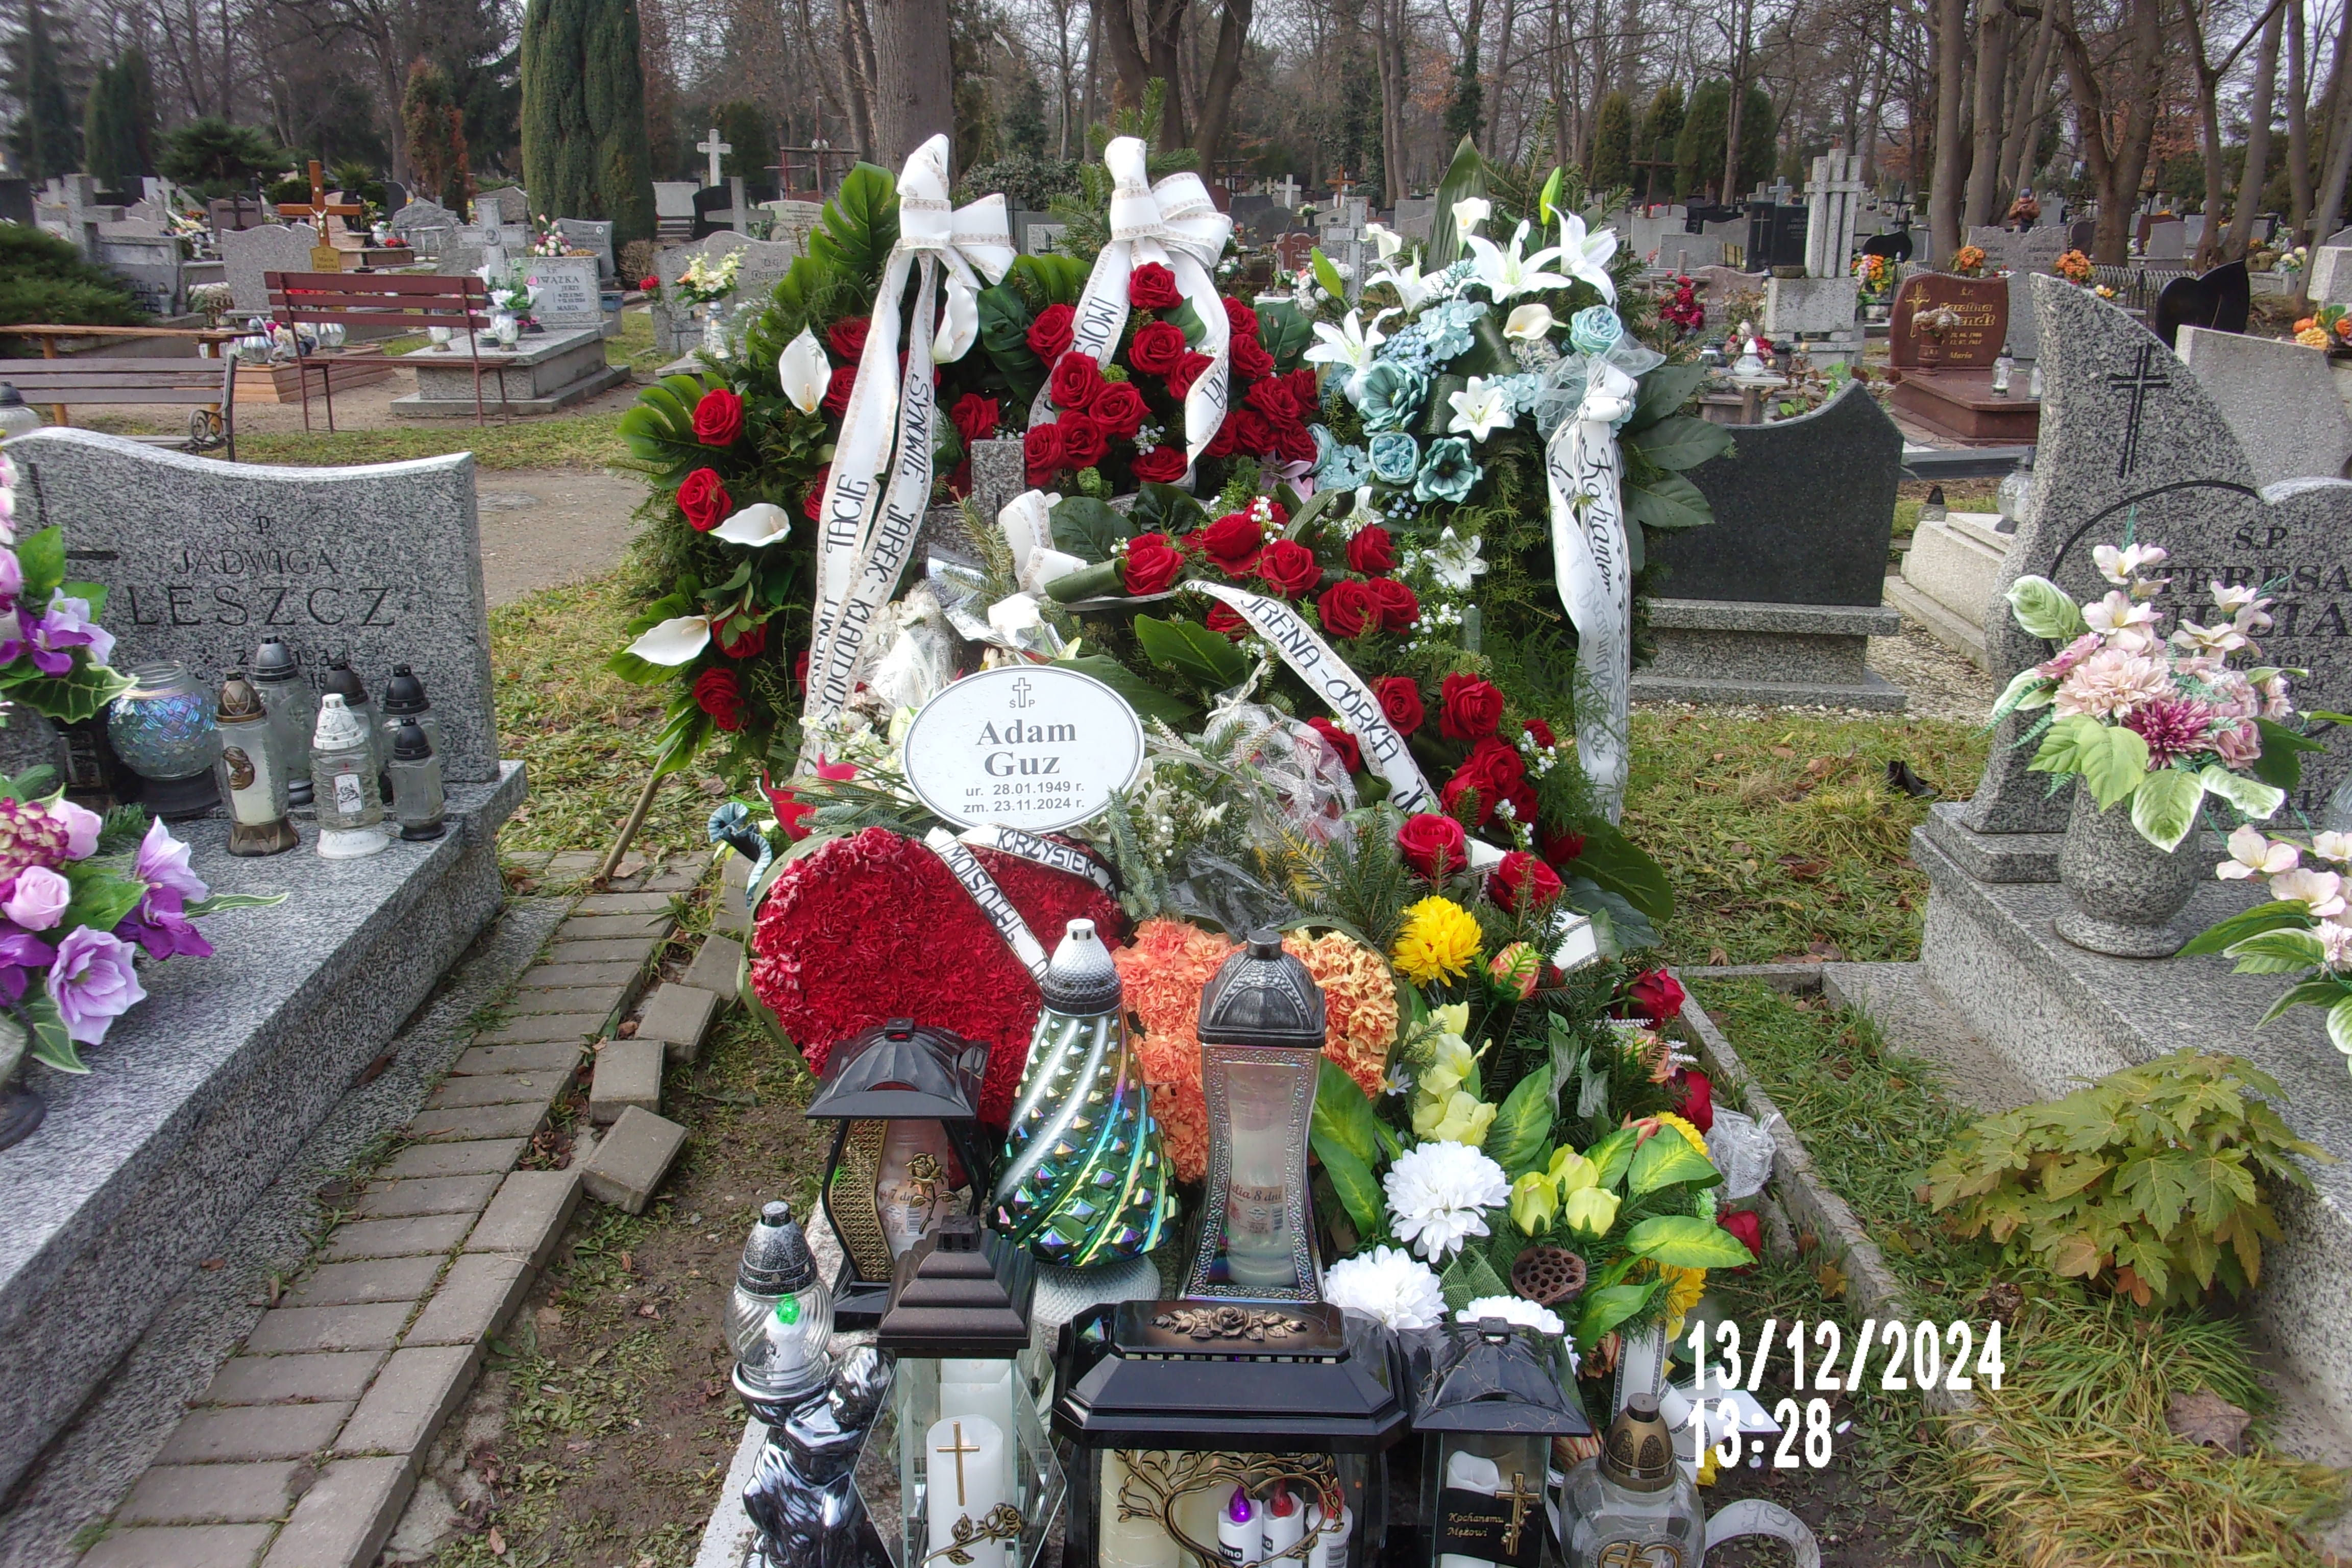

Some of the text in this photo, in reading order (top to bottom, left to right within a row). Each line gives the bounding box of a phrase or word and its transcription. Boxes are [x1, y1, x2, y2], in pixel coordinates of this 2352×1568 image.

[1958, 313, 1996, 326] endt
[902, 373, 929, 483] SYNOWIE
[826, 474, 869, 554] TACIE
[864, 503, 917, 583] JAREK
[174, 549, 340, 575] JADWIGA
[127, 585, 396, 627] LESZCZ
[975, 719, 1077, 745] Adam
[984, 751, 1060, 777] Guz
[965, 781, 1085, 796] ur. 28.01.1949 r.
[963, 797, 1085, 813] zm. 23.11.2024 r.
[997, 827, 1099, 879] KRZYSIEK
[1254, 1190, 1282, 1202] 8 dni
[1448, 1512, 1504, 1523] Kochanemu
[1447, 1526, 1489, 1538] Mężowi
